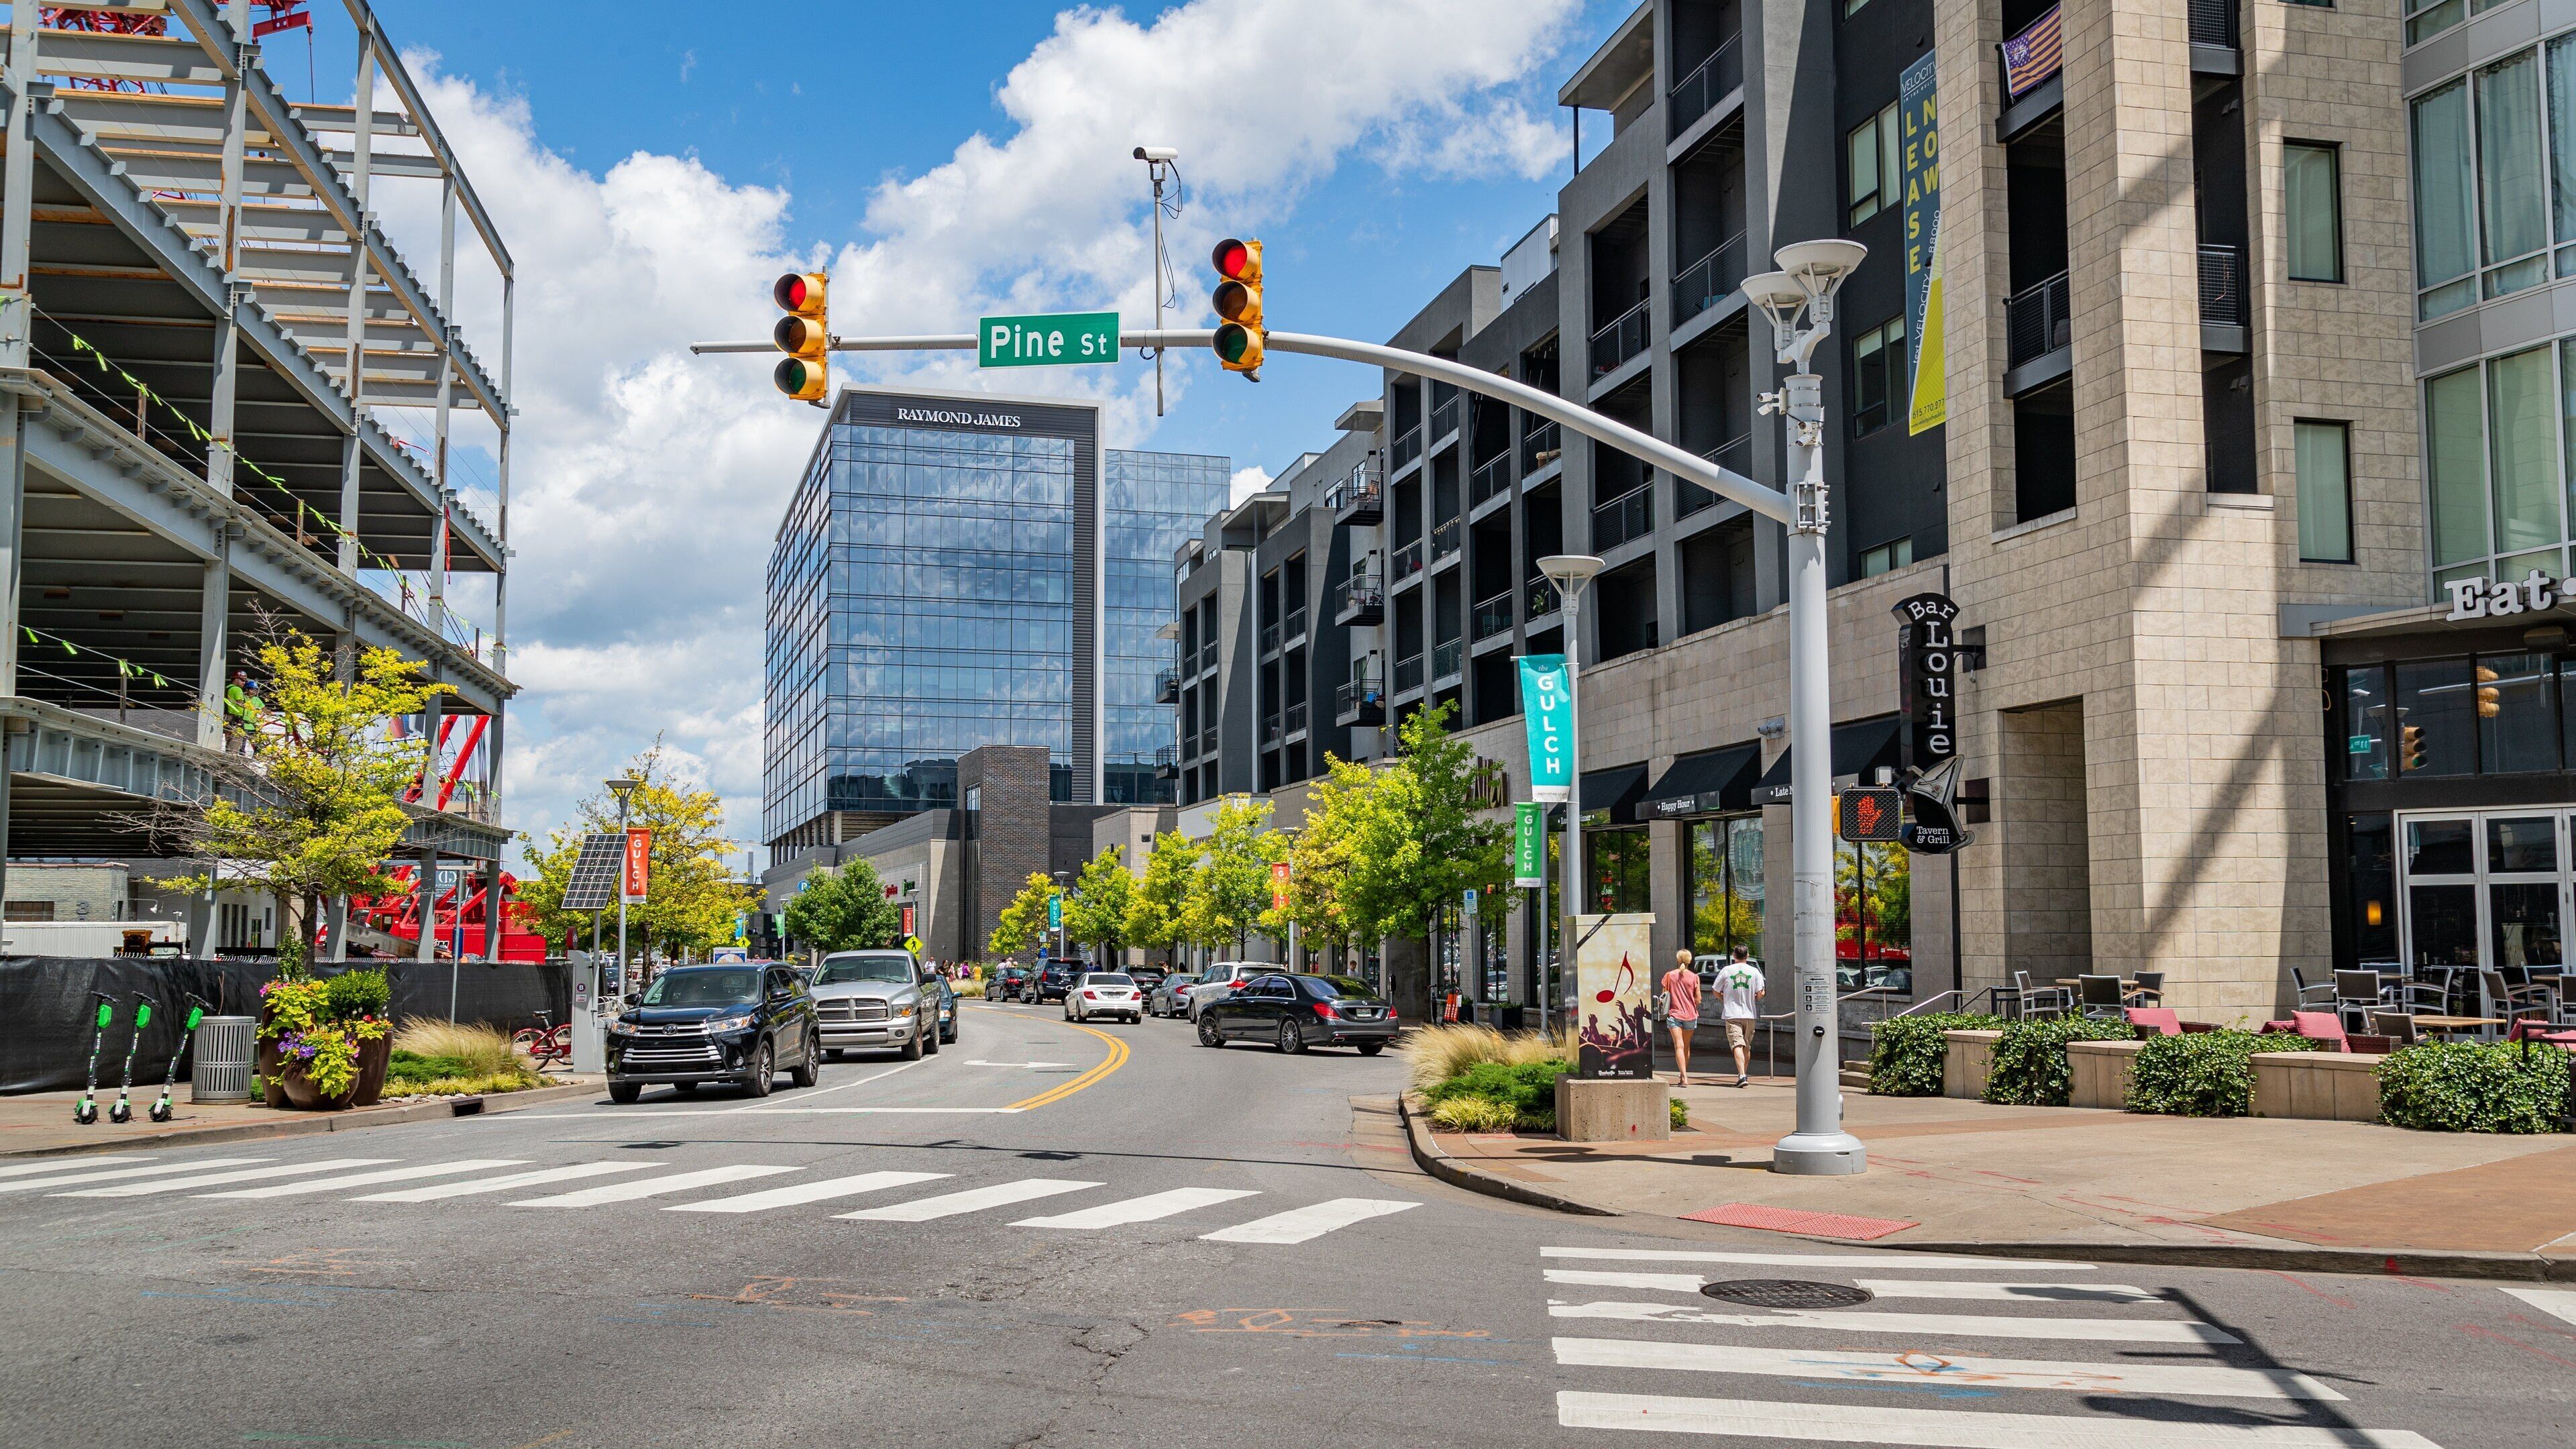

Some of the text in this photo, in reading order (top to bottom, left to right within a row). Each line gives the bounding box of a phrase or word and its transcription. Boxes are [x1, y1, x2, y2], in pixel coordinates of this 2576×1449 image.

[1923, 94, 1939, 195] NOW
[1907, 111, 1921, 274] LEASE
[1928, 210, 1940, 254] 88000
[991, 324, 1107, 358] Pine St
[898, 408, 1020, 427] RAYMOND JAMES
[1913, 398, 1945, 419] 615.770.277
[1908, 601, 1953, 621] Bar
[2444, 569, 2553, 622] Eat
[1926, 621, 1949, 754] Louie
[1538, 676, 1560, 774] GULCH
[1661, 800, 1690, 812] Happy Hour
[1775, 788, 1788, 797] Late
[1524, 815, 1533, 871] GULCH
[1916, 826, 1949, 835] Tavern
[1917, 835, 1950, 844] & Grill
[632, 839, 642, 890] GULCH
